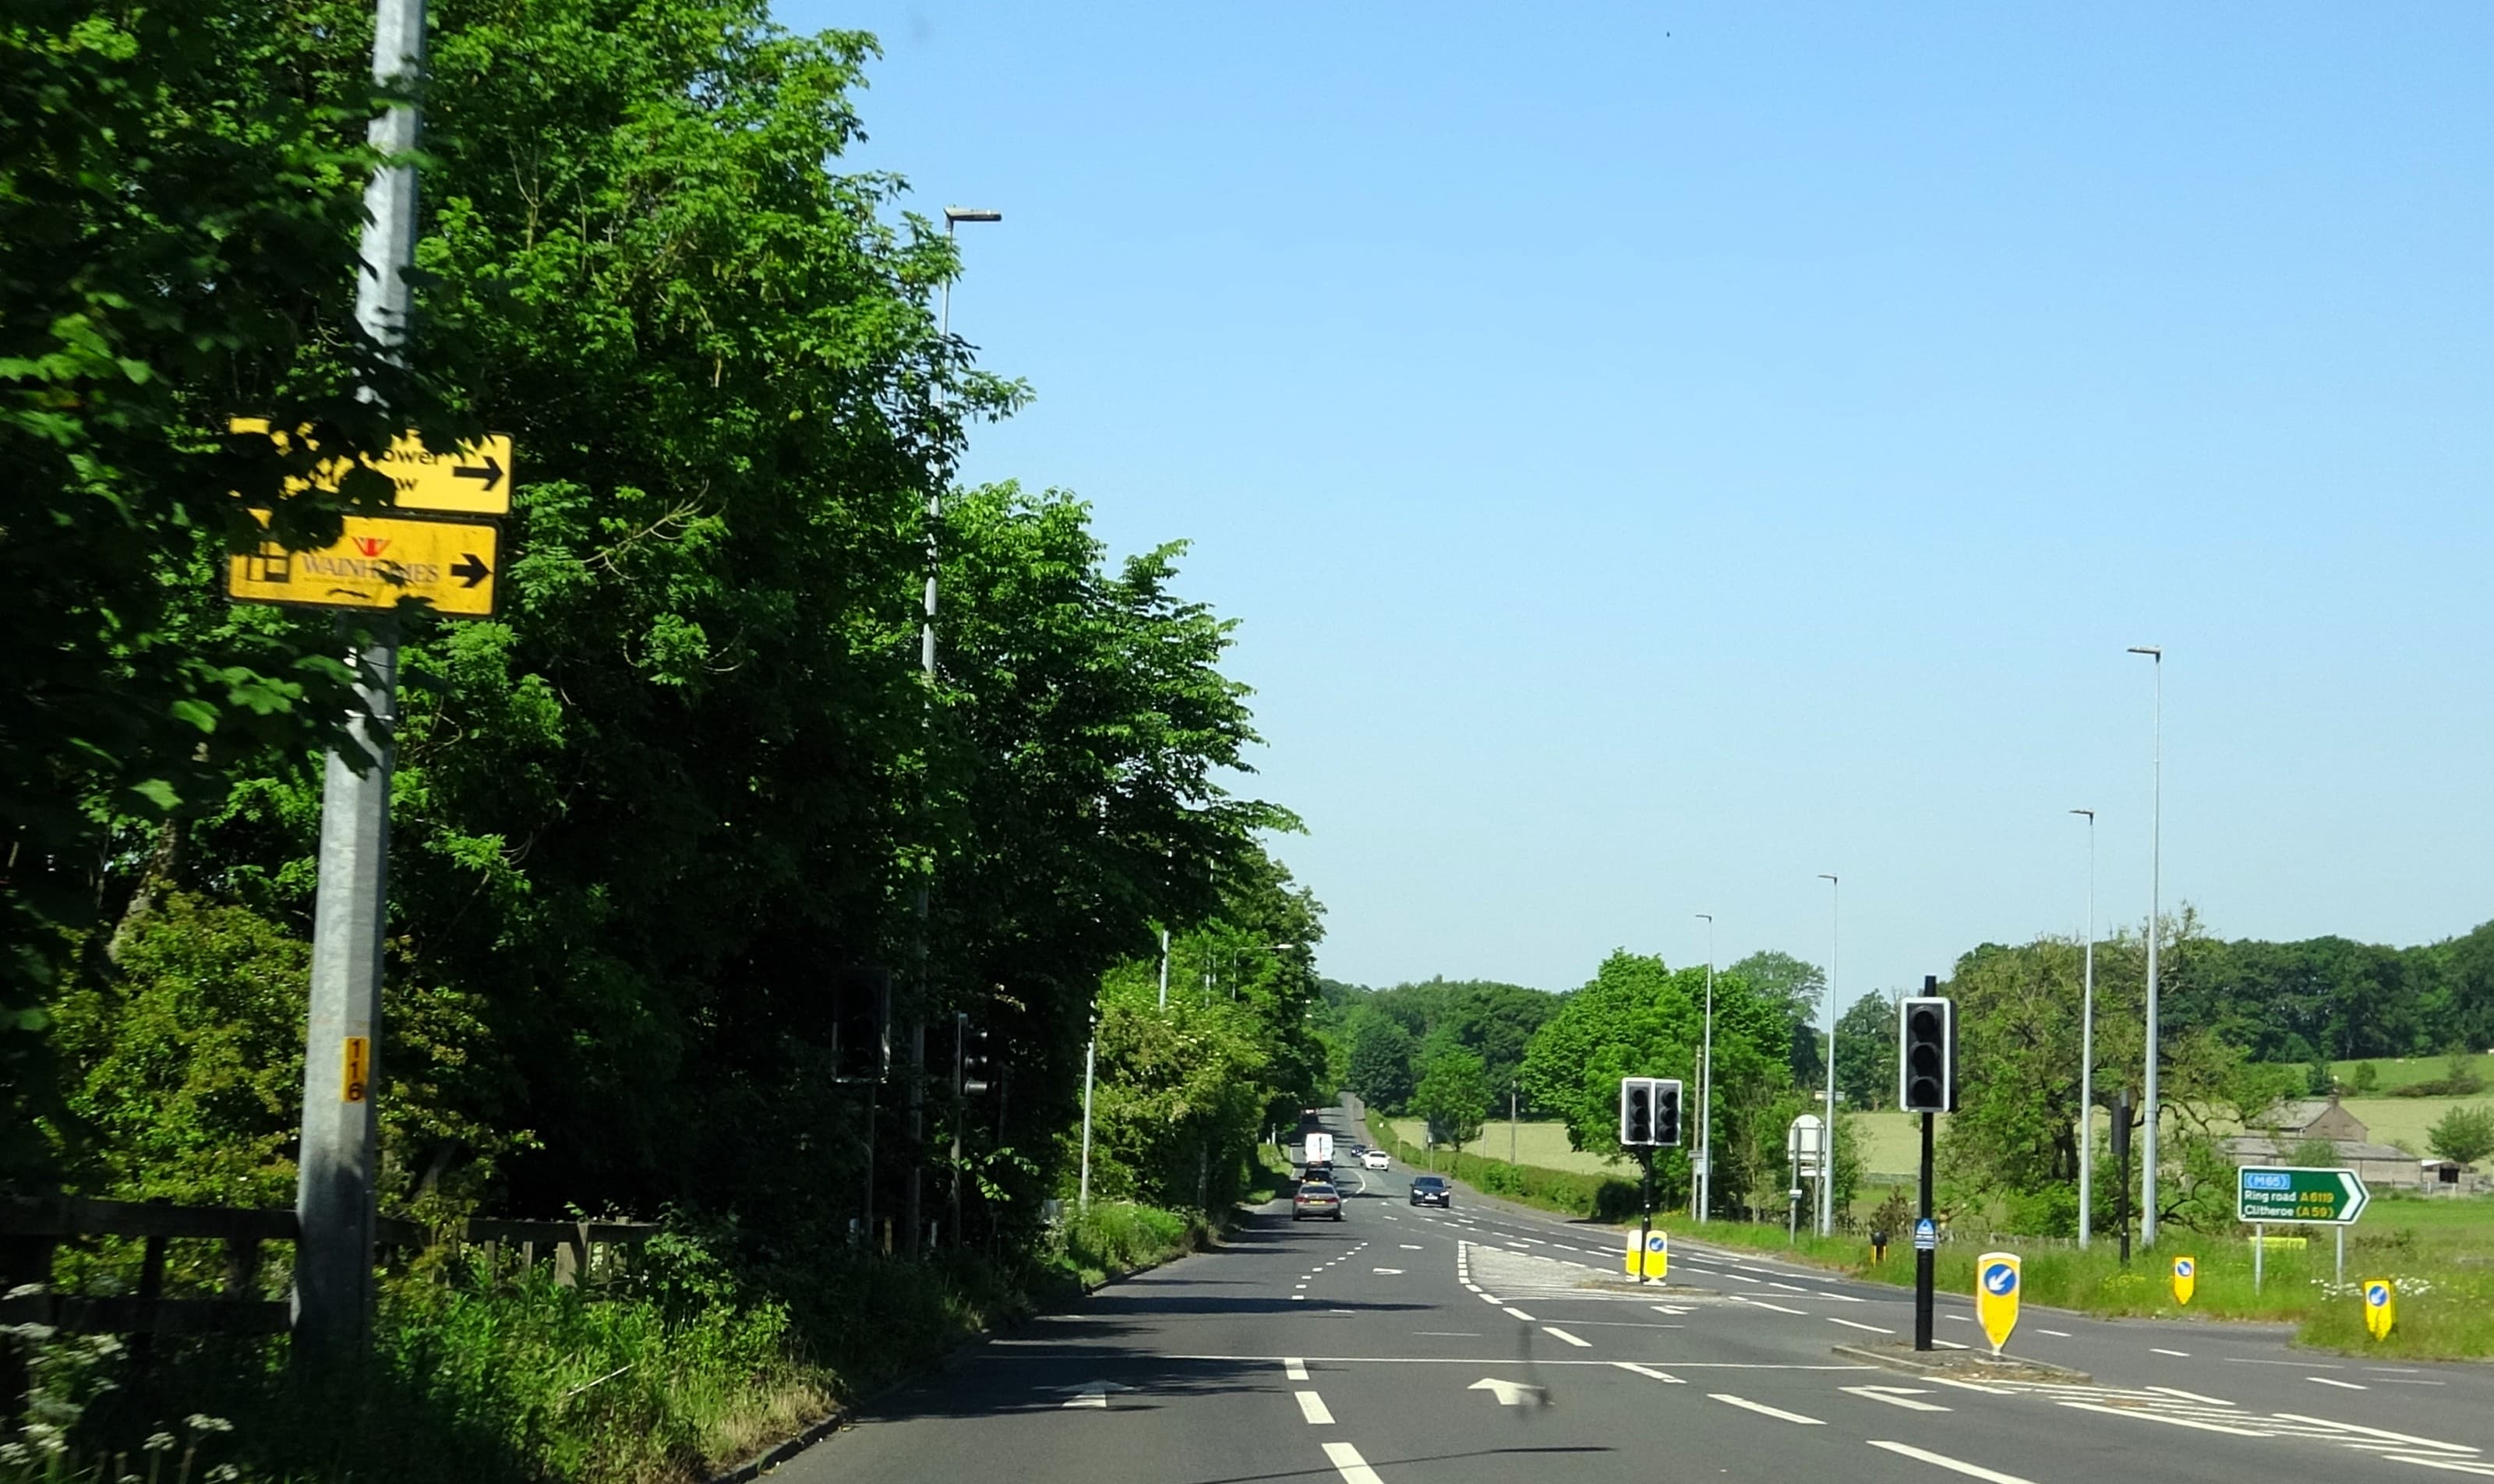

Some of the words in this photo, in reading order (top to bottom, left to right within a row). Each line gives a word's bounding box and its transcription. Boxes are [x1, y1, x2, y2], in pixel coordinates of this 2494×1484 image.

[383, 448, 439, 465] ower
[2244, 1190, 2269, 1203] Ring
[2271, 1192, 2296, 1202] road
[2244, 1205, 2294, 1217] Clitheroe
